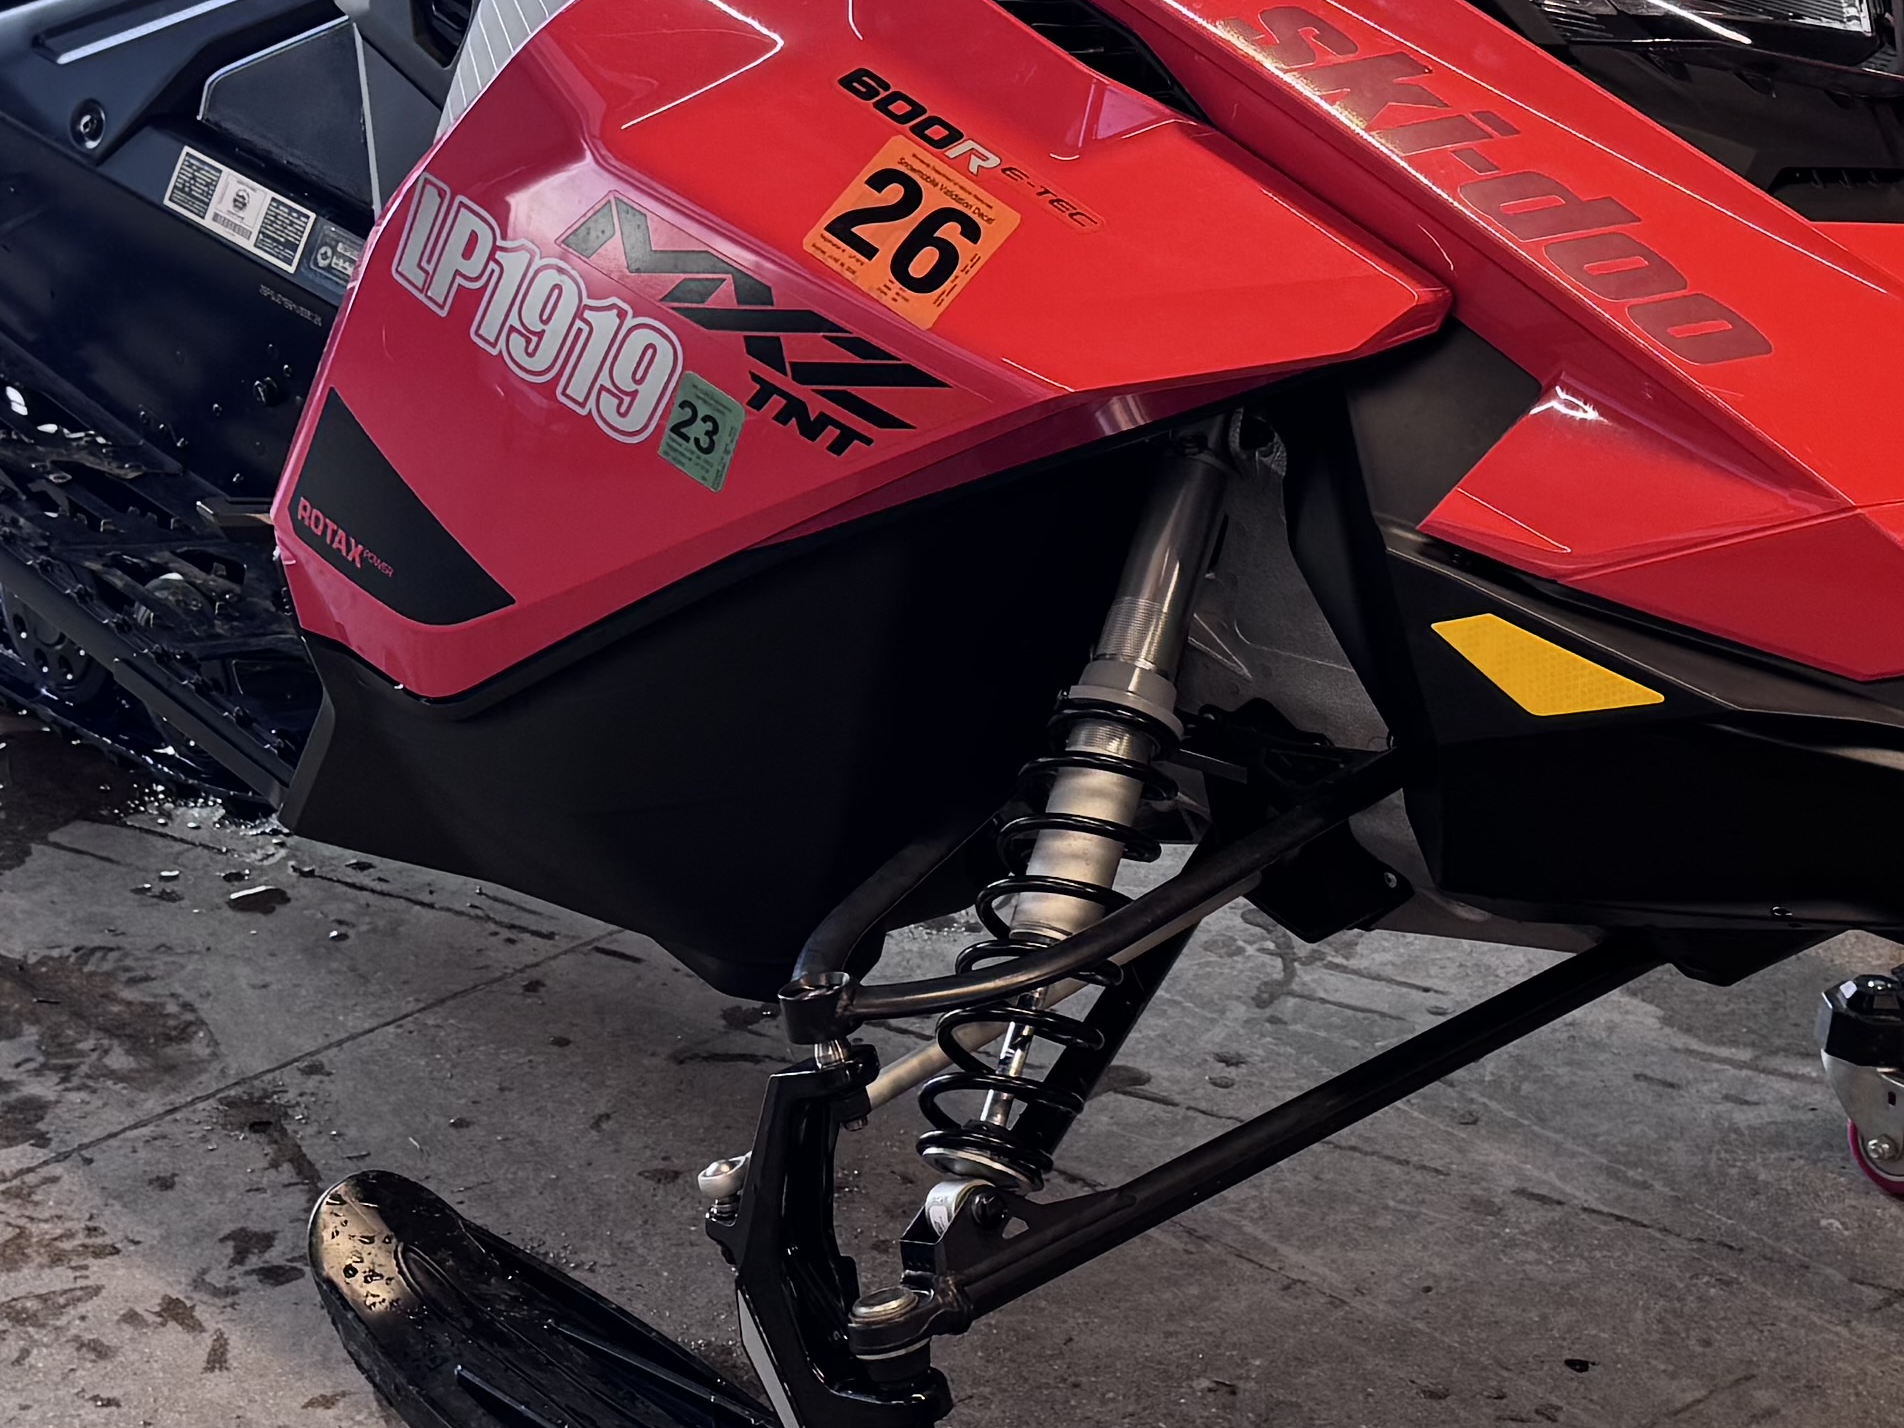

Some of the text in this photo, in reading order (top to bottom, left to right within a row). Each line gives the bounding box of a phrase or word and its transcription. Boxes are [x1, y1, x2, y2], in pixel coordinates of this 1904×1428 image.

[1000, 166, 1099, 228] E-TEC
[1218, 5, 1774, 366] ski-doo
[823, 167, 982, 295] 26
[393, 173, 683, 444] LP1919
[669, 399, 720, 455] 23
[746, 370, 874, 457] TNT
[298, 496, 394, 577] ROTAX POWER
